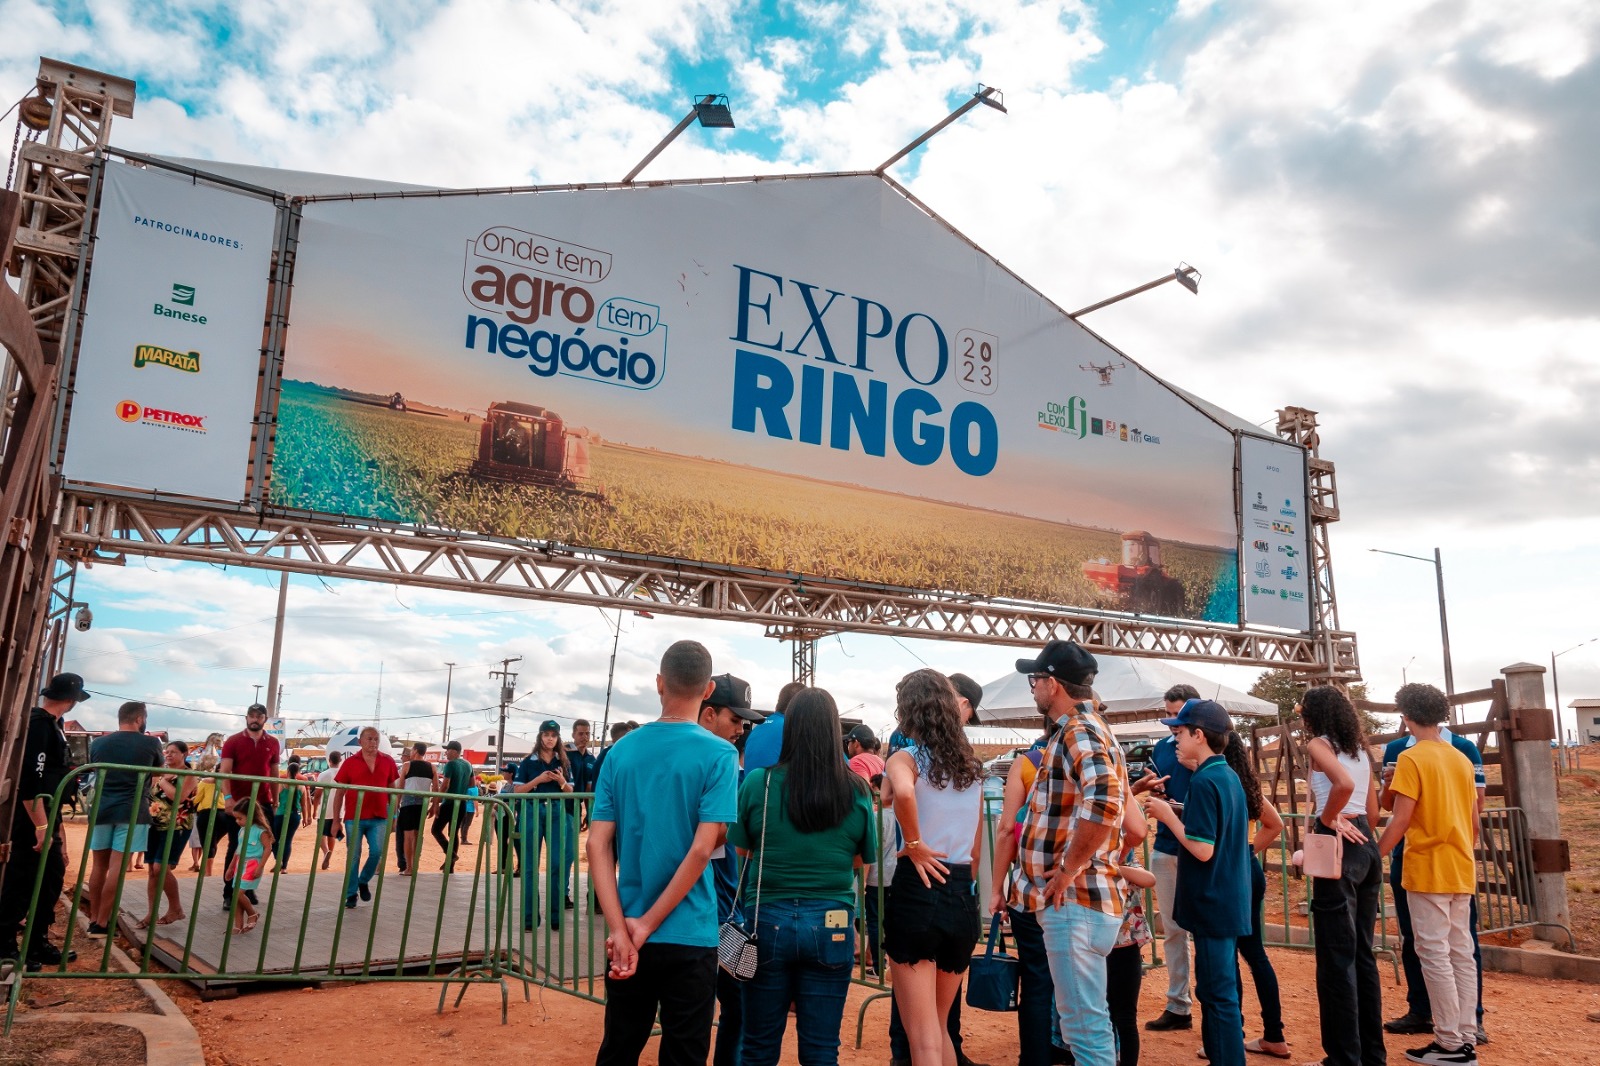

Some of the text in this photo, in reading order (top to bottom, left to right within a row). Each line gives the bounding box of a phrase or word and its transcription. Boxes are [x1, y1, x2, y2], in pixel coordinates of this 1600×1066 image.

[134, 215, 243, 250] PATROCINADORES:
[483, 232, 602, 278] onde tem
[470, 264, 595, 325] agro
[153, 303, 207, 325] Banese
[606, 302, 652, 333] tem
[729, 264, 949, 386] EXPO
[465, 314, 656, 385] negócio
[143, 406, 204, 428] PETROX
[731, 348, 999, 477] RINGO
[1038, 411, 1066, 428] PLEXO
[1047, 402, 1066, 416] COM
